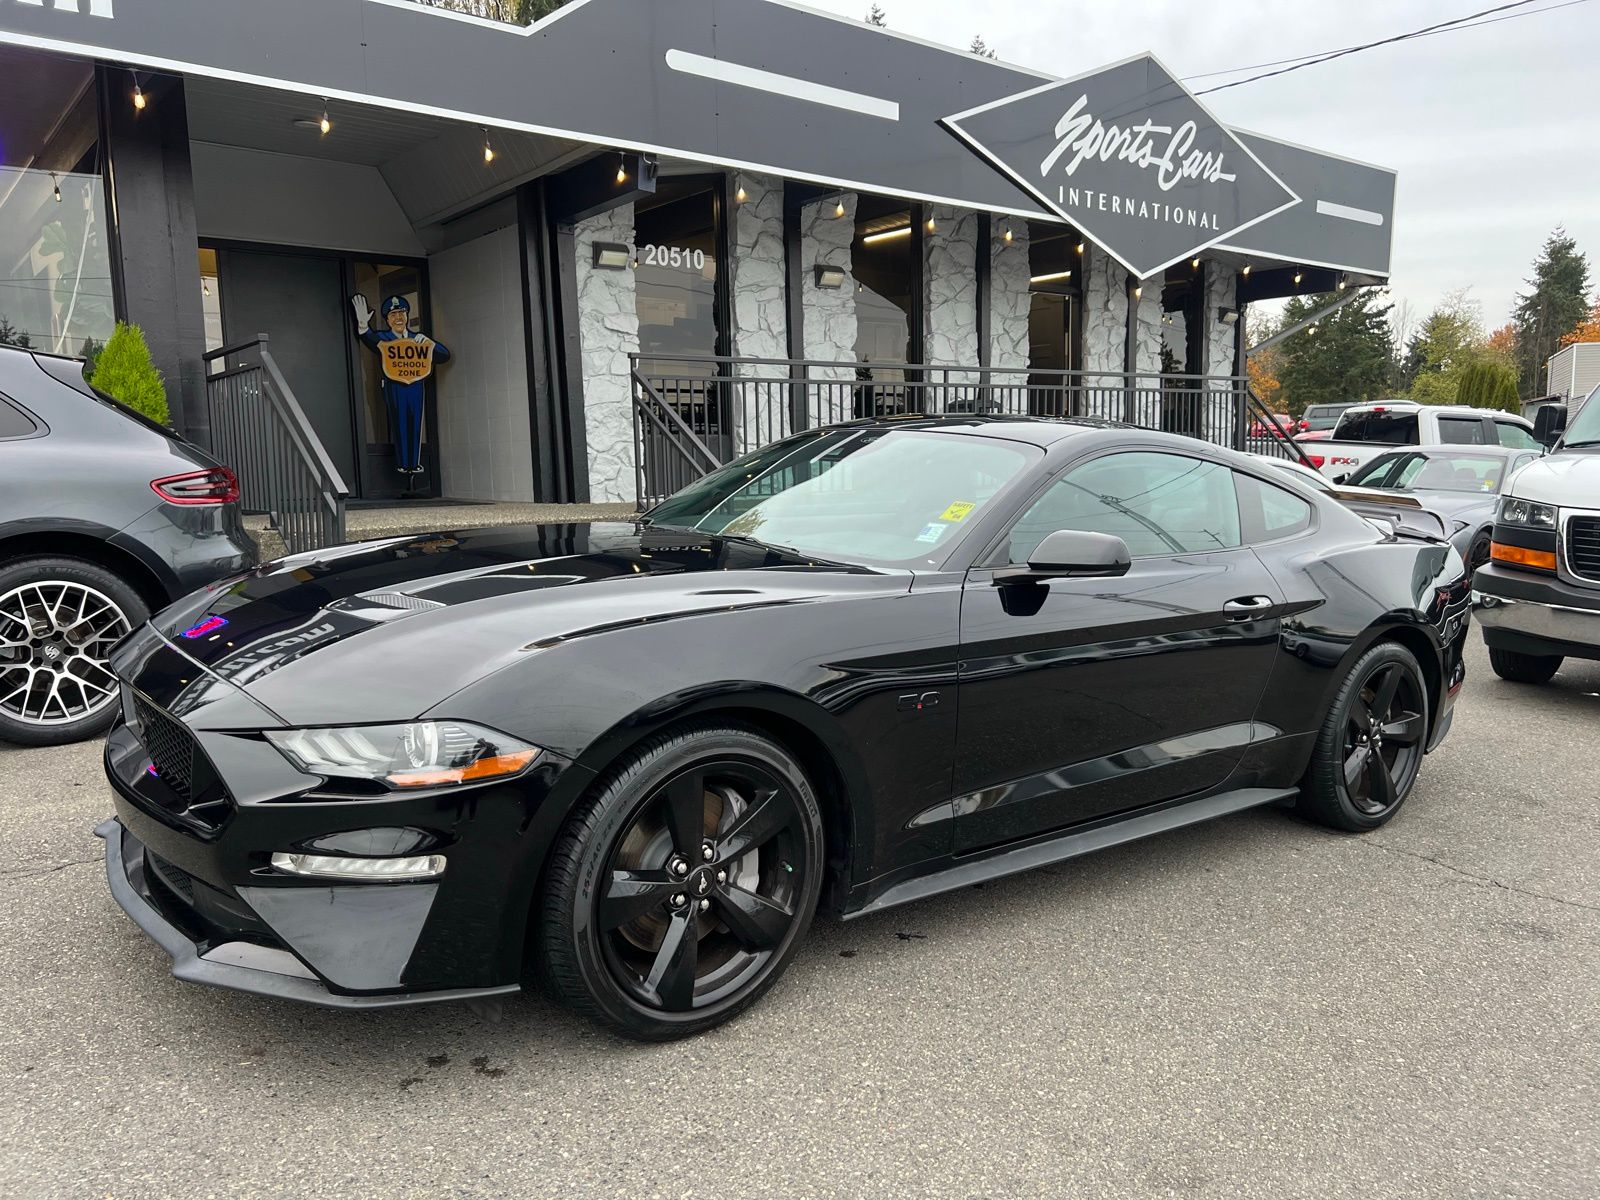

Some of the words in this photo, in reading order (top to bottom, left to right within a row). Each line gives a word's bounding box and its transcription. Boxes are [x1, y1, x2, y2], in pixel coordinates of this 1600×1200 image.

[1040, 94, 1172, 177] Sports
[1158, 120, 1236, 191] Cars
[1059, 185, 1220, 230] INTERNATIONAL
[645, 244, 704, 269] 20510
[387, 346, 429, 360] SLOW
[1330, 456, 1360, 466] FX4
